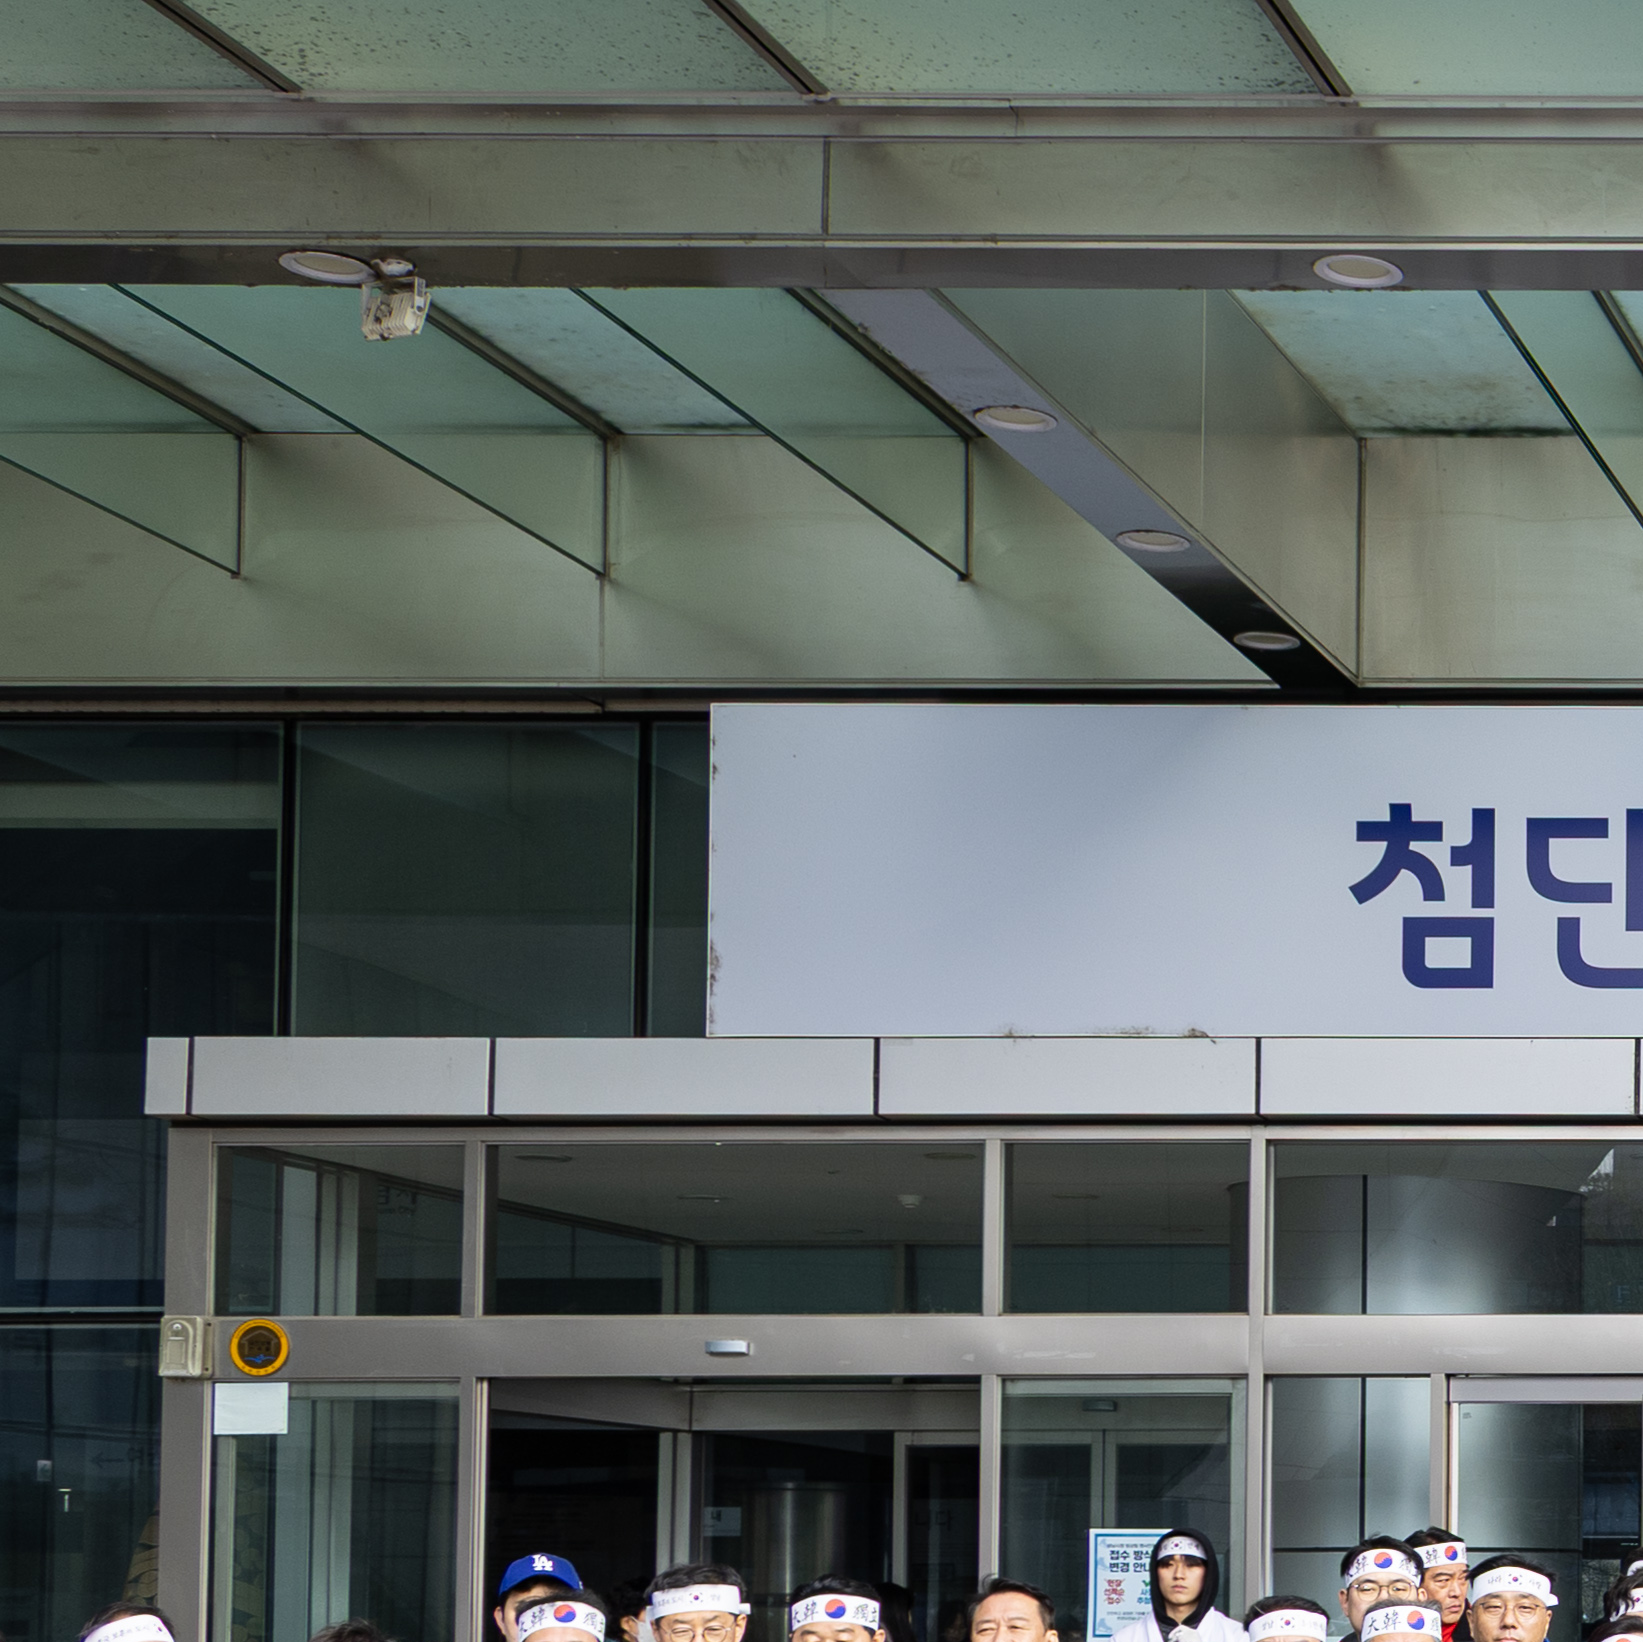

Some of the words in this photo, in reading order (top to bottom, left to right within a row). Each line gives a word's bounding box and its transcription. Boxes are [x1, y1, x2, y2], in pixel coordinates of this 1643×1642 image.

[1109, 1550, 1130, 1561] 접수
[532, 1554, 554, 1572] LA
[1109, 1562, 1130, 1573] 변경
[1366, 1611, 1402, 1636] 大韓
